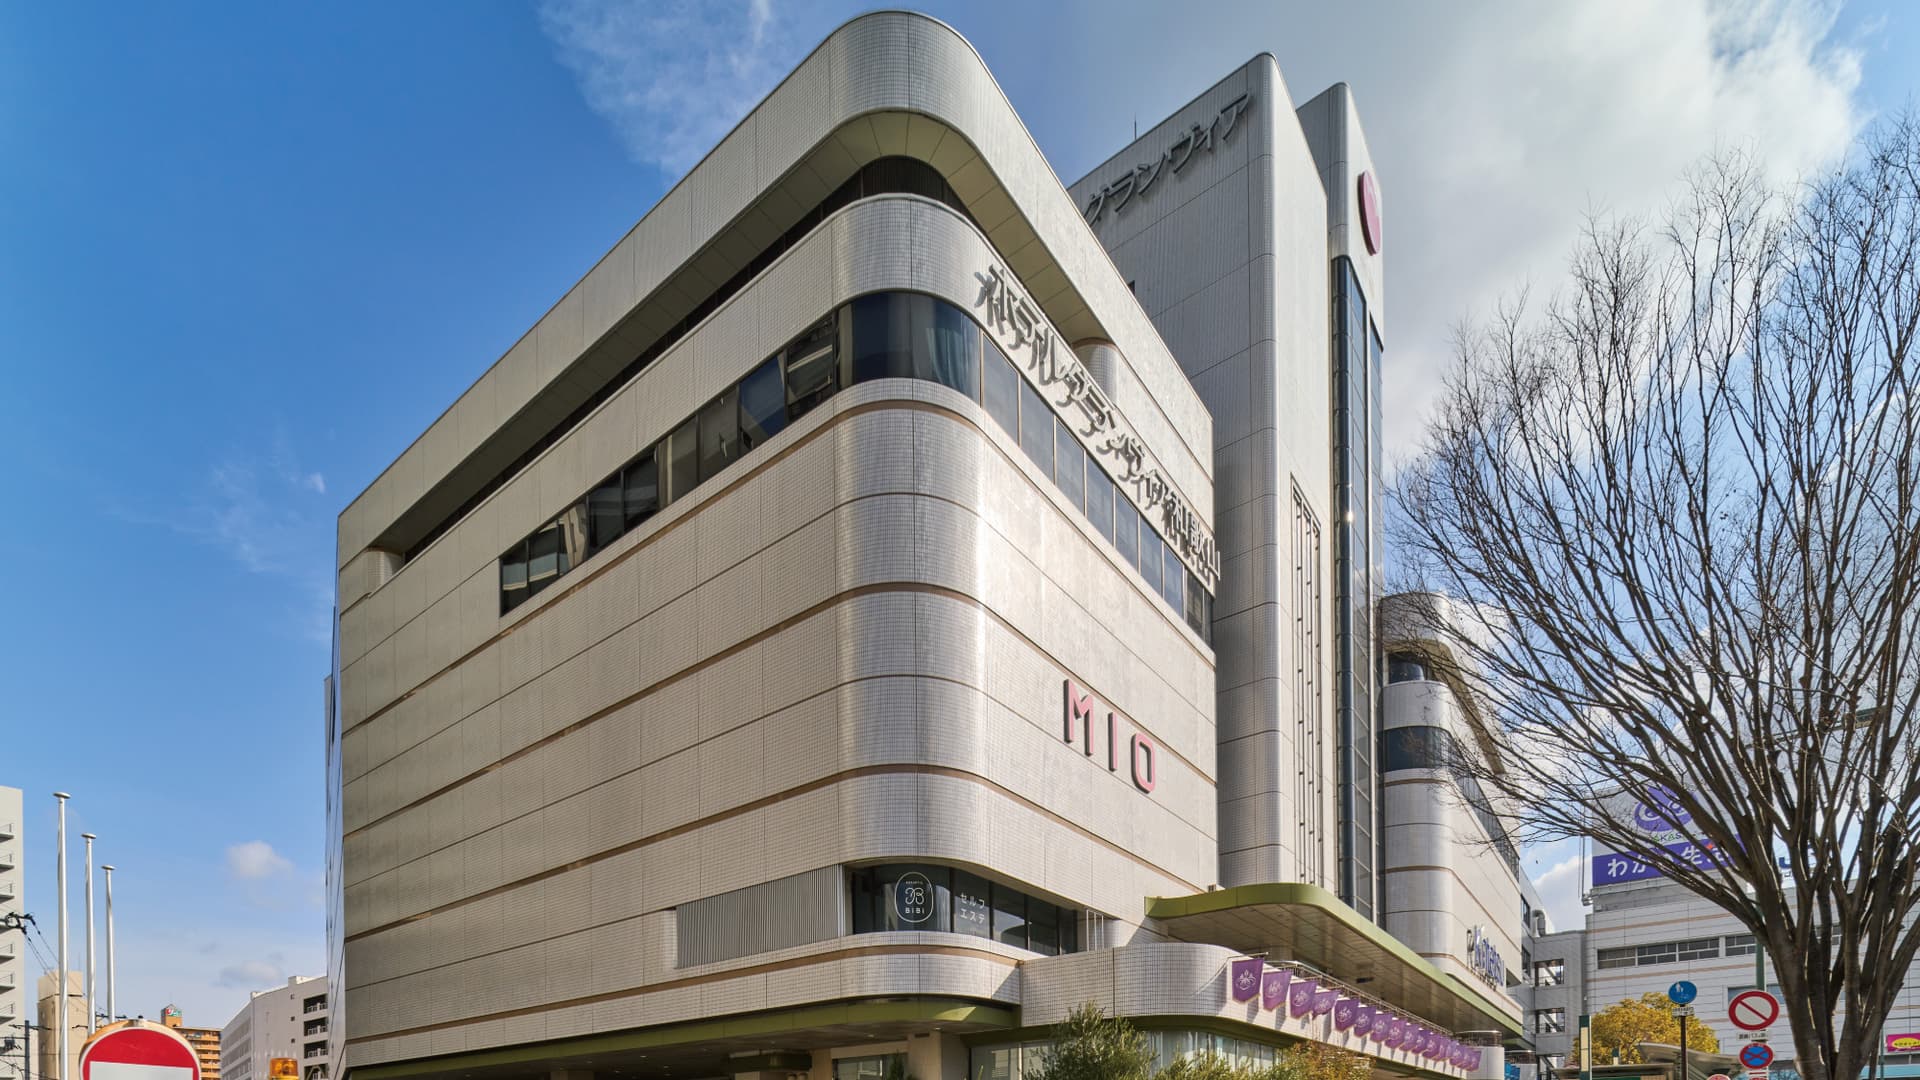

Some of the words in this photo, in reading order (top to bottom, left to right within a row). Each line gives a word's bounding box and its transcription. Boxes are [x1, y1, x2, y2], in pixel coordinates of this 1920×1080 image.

[1063, 679, 1156, 794] MIO
[960, 892, 985, 909] セルフ
[960, 908, 985, 924] エステ
